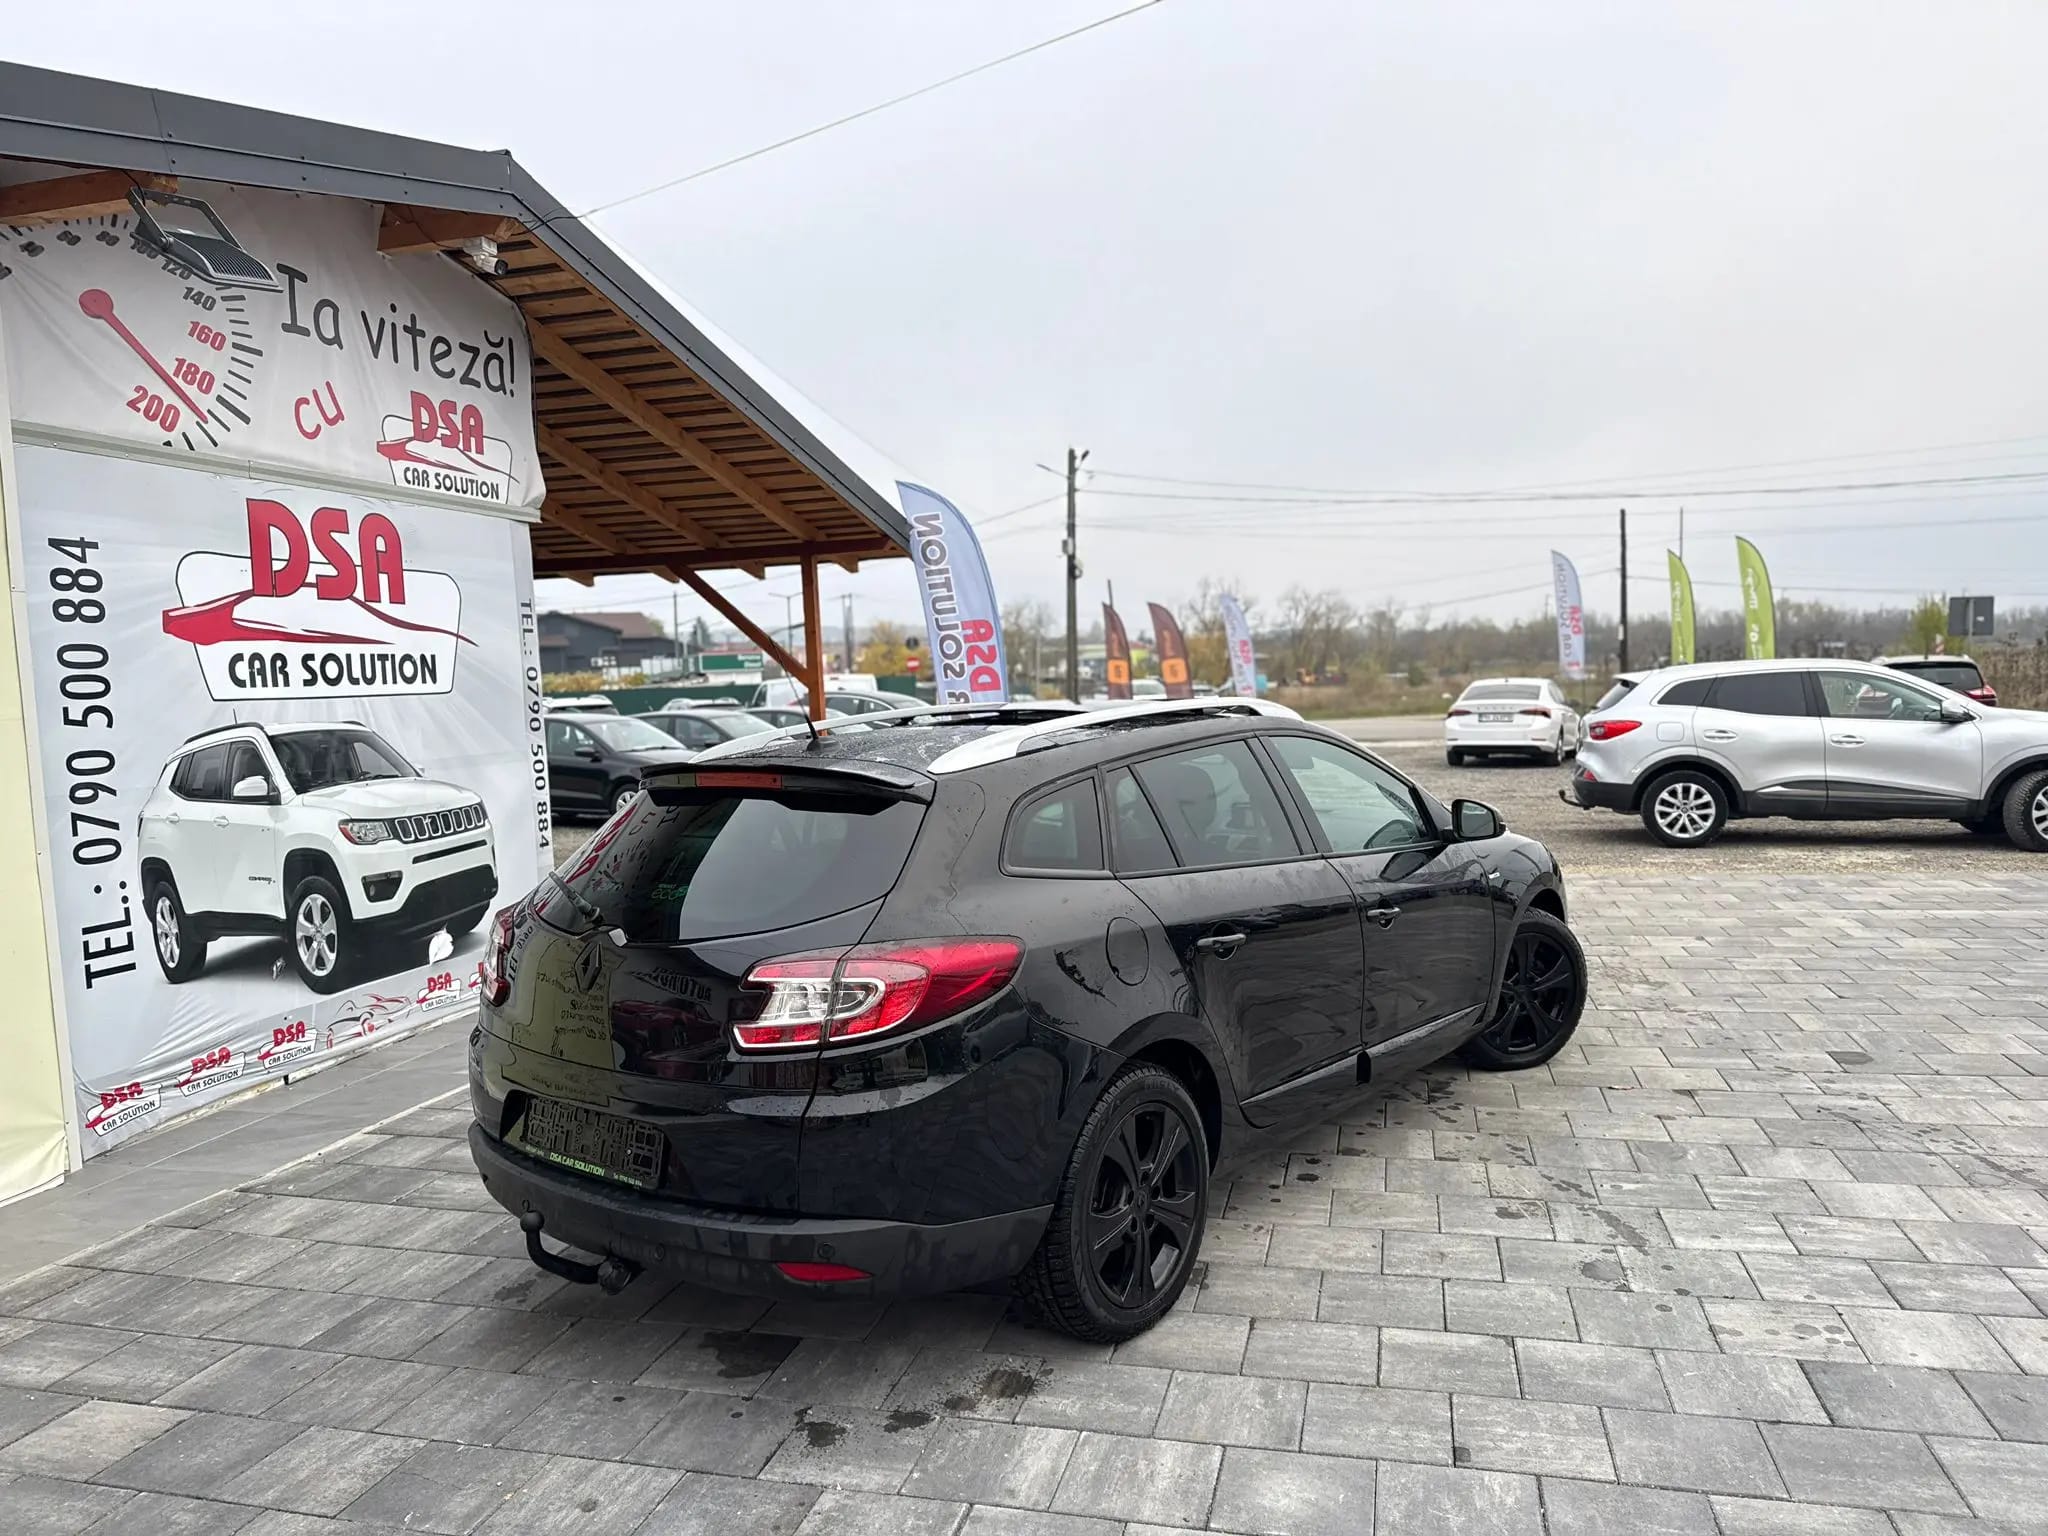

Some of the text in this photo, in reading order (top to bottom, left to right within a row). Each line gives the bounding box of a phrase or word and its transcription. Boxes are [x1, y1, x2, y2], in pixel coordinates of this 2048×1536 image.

[160, 259, 193, 281] 120
[182, 286, 217, 312] 140
[187, 320, 227, 352] 160
[276, 262, 515, 398] Ia viteză!
[172, 357, 216, 395] 180
[125, 384, 181, 433] 200
[294, 381, 345, 440] cu
[410, 390, 485, 456] DSA
[403, 466, 500, 501] CAR SOLUTION
[246, 497, 406, 605] DSA
[48, 535, 107, 624] 884
[56, 643, 114, 729] 500
[228, 651, 438, 689] CAR SOLUTION
[526, 666, 541, 732] 0790
[531, 743, 547, 792] 500
[66, 749, 123, 866] 0790
[536, 801, 550, 849] 884
[427, 971, 452, 993] DSA
[273, 1020, 305, 1047] DSA
[191, 1046, 231, 1075] DSA
[268, 1044, 312, 1065] CAR SOLUTION
[101, 1082, 144, 1110] DSA
[187, 1069, 239, 1093] CAR SOLUTION
[101, 1099, 156, 1132] CAR SOLUTION
[550, 1152, 605, 1177] DSA CAR SOLUTION
